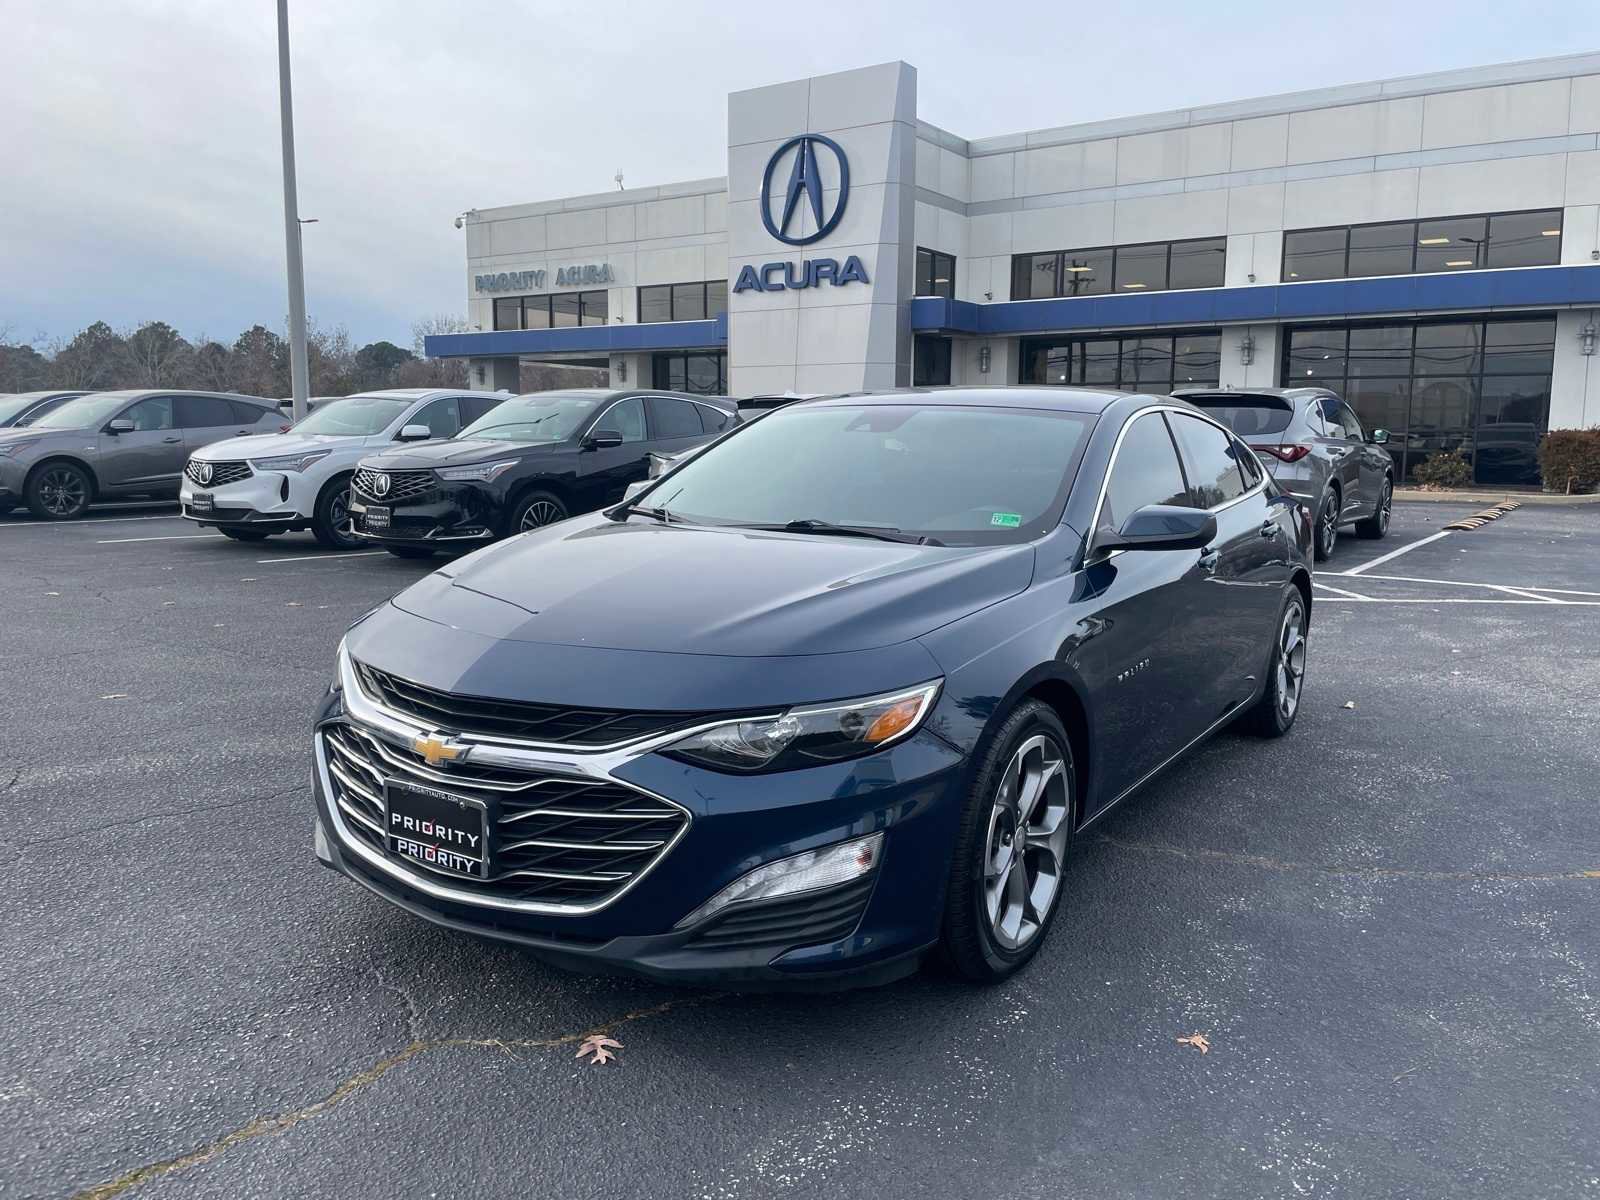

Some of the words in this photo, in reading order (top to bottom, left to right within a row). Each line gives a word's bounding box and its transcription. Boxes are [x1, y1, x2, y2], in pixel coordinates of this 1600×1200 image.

[475, 270, 545, 292] PRIORITY
[555, 264, 615, 285] ACURA
[733, 255, 870, 293] ACURA
[392, 812, 479, 848] PRIORITY
[398, 840, 474, 873] PRIORITY
